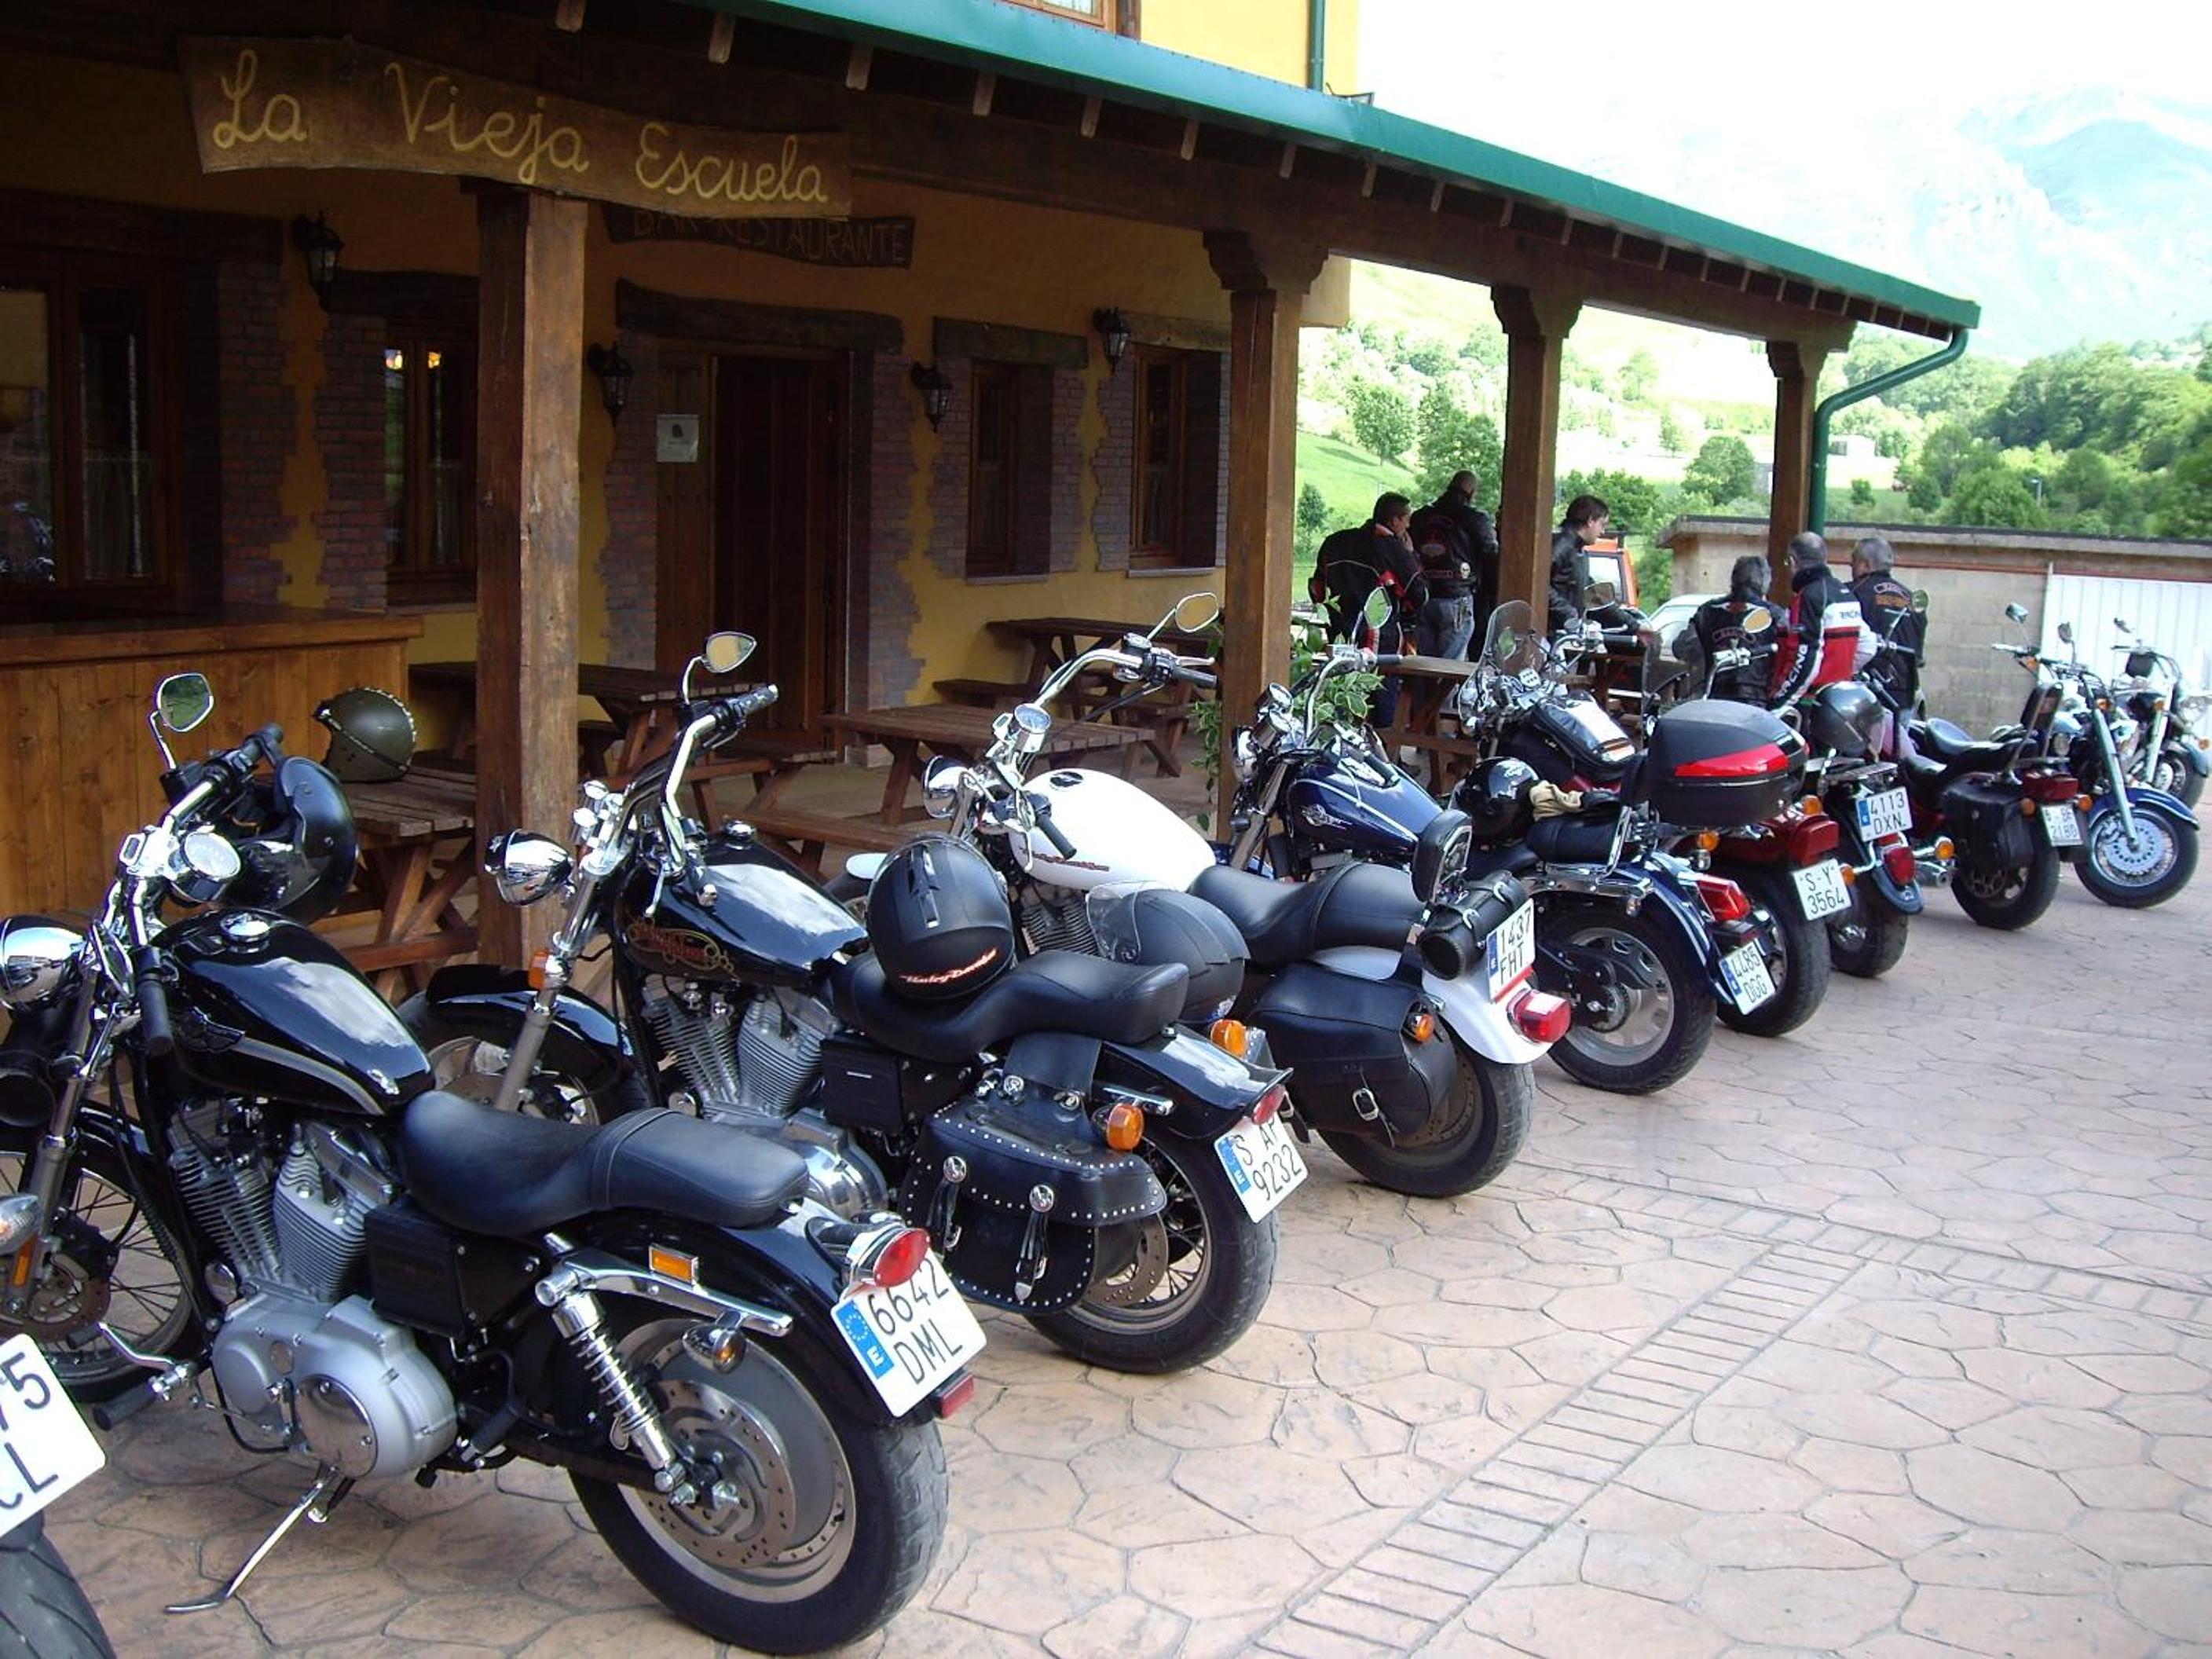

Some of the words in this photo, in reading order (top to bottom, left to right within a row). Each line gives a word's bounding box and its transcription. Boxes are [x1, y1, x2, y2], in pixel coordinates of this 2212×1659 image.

[213, 49, 307, 149] La
[385, 60, 590, 185] Vieja
[635, 120, 829, 203] Escuela
[1871, 791, 1904, 815] 4113
[1804, 872, 1816, 892] S
[1821, 866, 1833, 886] Y
[1807, 887, 1845, 915] 3564
[1500, 906, 1531, 955] 1437
[1499, 942, 1524, 985] FHT
[1730, 945, 1761, 977] 4485
[1231, 1133, 1254, 1166] S
[1252, 1144, 1302, 1202] 9232
[867, 1257, 950, 1335] 6642
[866, 1345, 885, 1368] E
[893, 1318, 963, 1385] DML
